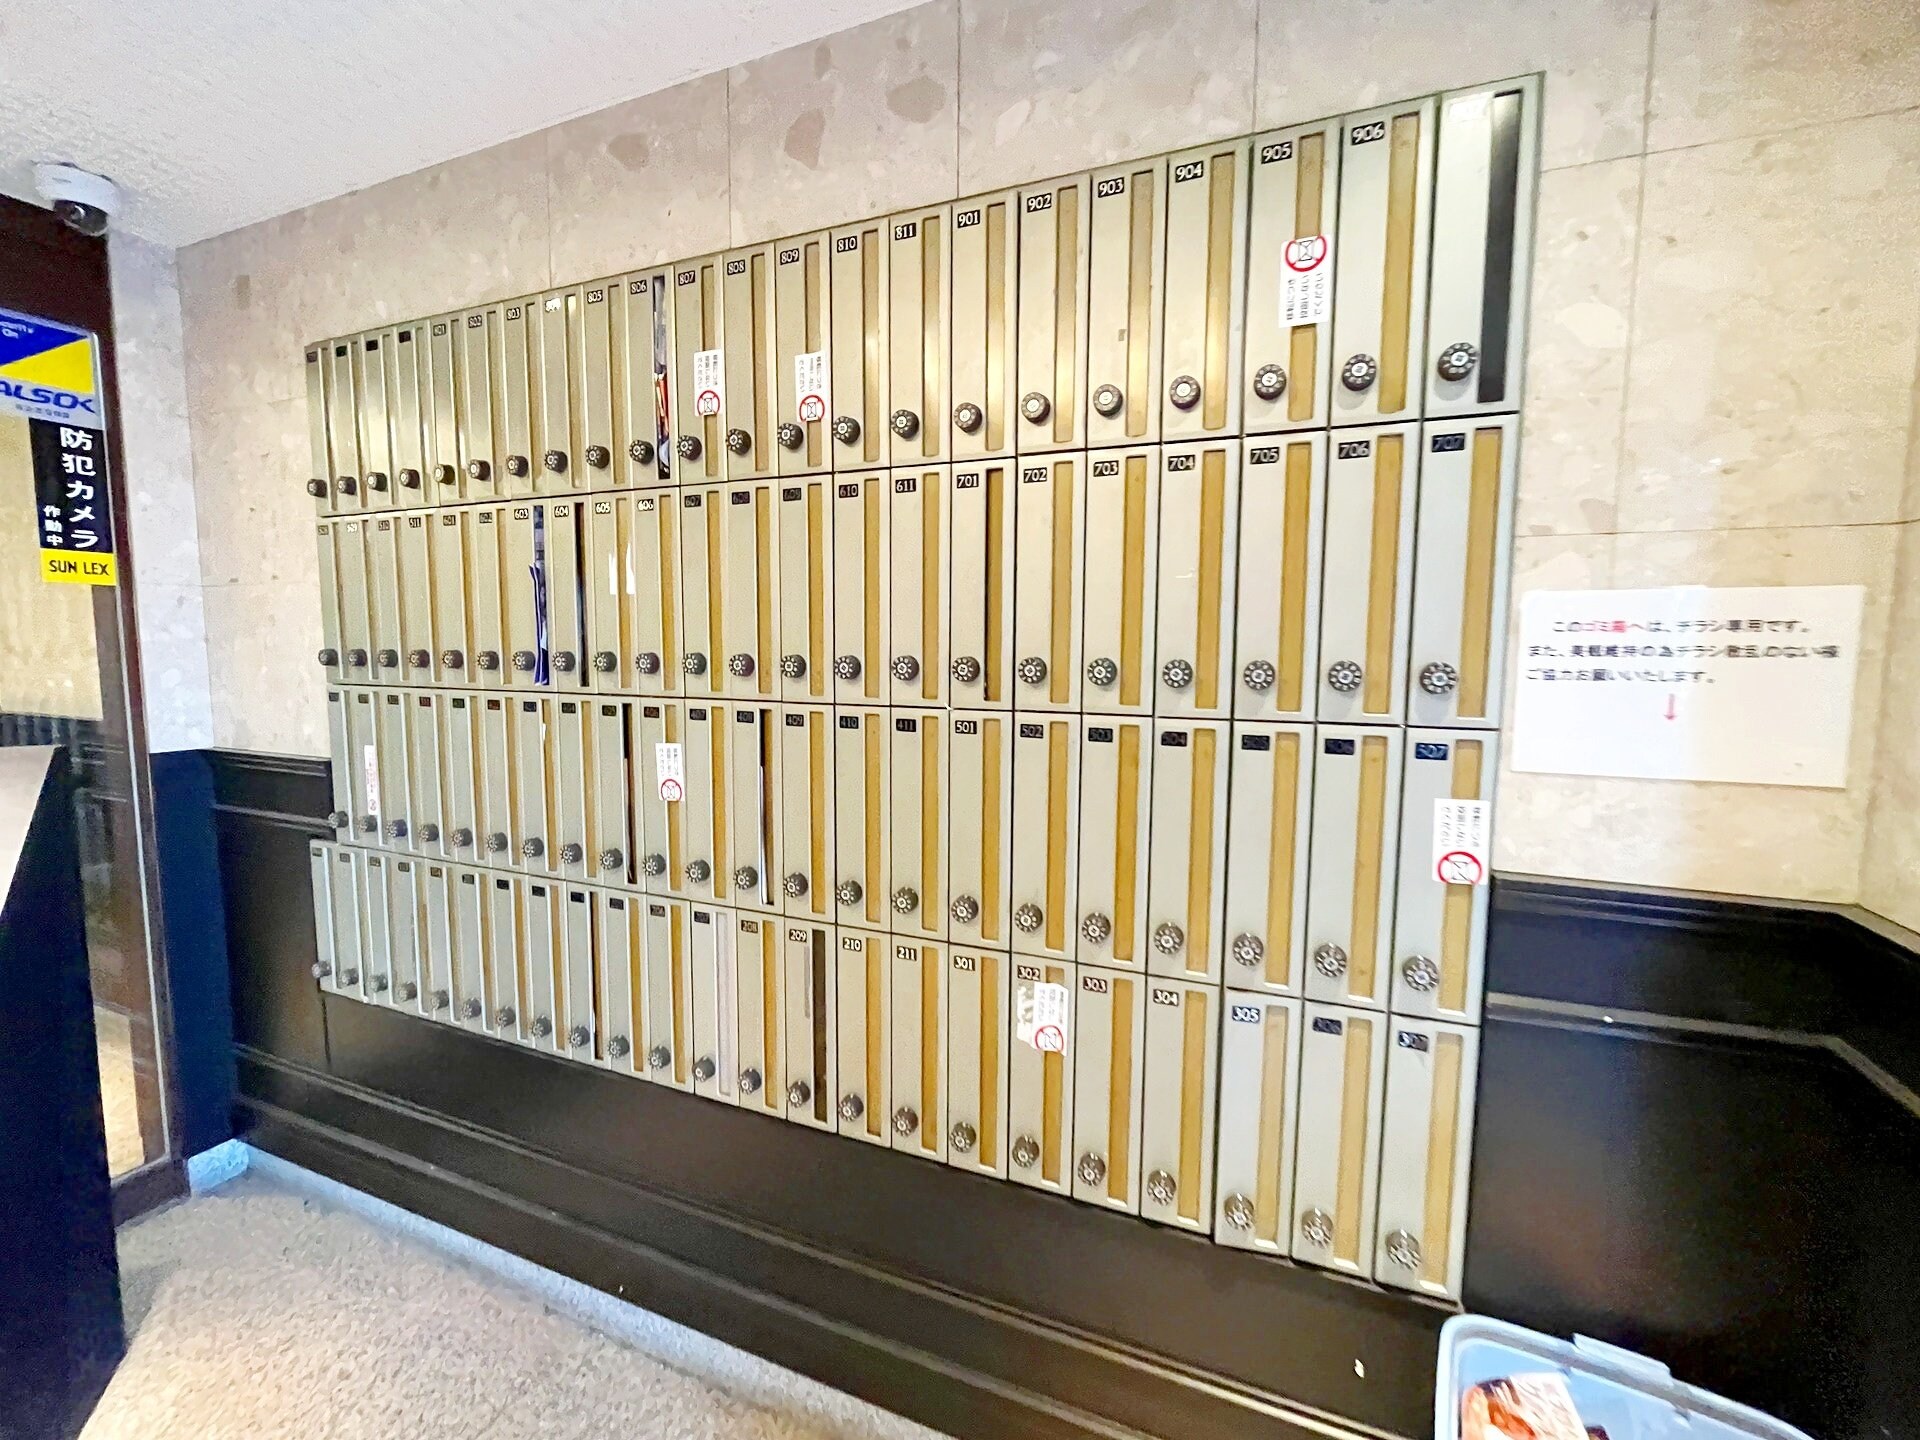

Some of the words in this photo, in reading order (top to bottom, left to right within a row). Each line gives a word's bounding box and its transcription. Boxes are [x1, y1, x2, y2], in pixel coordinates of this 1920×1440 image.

[1353, 123, 1384, 143] 906
[1262, 144, 1291, 162] 905
[1177, 163, 1202, 180] 904
[1099, 179, 1123, 195] 903
[1028, 195, 1051, 210] 902
[958, 212, 979, 227] 901
[896, 224, 915, 239] 811
[838, 238, 856, 251] 810
[781, 250, 798, 263] 809
[728, 261, 744, 274] 808
[679, 272, 695, 285] 807
[630, 281, 646, 293] 806
[588, 290, 602, 302] 805
[507, 308, 520, 320] 803
[469, 316, 482, 328] 802
[0, 380, 96, 414] ALSOK
[1340, 442, 1369, 457] 706
[1434, 435, 1464, 451] 707
[1252, 449, 1279, 463] 705
[1095, 463, 1118, 475] 703
[1170, 456, 1195, 470] 704
[958, 475, 978, 488] 701
[1025, 469, 1046, 481] 702
[60, 426, 99, 549] 防犯カメラ
[840, 486, 857, 497] 610
[897, 480, 915, 491] 611
[784, 489, 801, 500] 609
[596, 502, 610, 513] 605
[638, 500, 653, 510] 606
[685, 496, 700, 507] 607
[514, 509, 528, 519] 603
[555, 506, 569, 517] 604
[44, 505, 64, 547] 作動中
[410, 518, 420, 528] 511
[49, 560, 77, 574] SUN
[83, 562, 109, 576] LEX
[690, 709, 705, 719] 407
[787, 715, 803, 726] 409
[841, 717, 857, 728] 410
[897, 720, 915, 731] 411
[956, 721, 975, 733] 501
[1021, 725, 1043, 738] 502
[790, 930, 806, 941] 209
[844, 939, 861, 951] 210
[898, 947, 916, 960] 211
[955, 957, 973, 970] 301
[1019, 966, 1039, 980] 302
[1084, 977, 1106, 992] 303
[1154, 989, 1178, 1006] 304
[1233, 1006, 1259, 1023] 305
